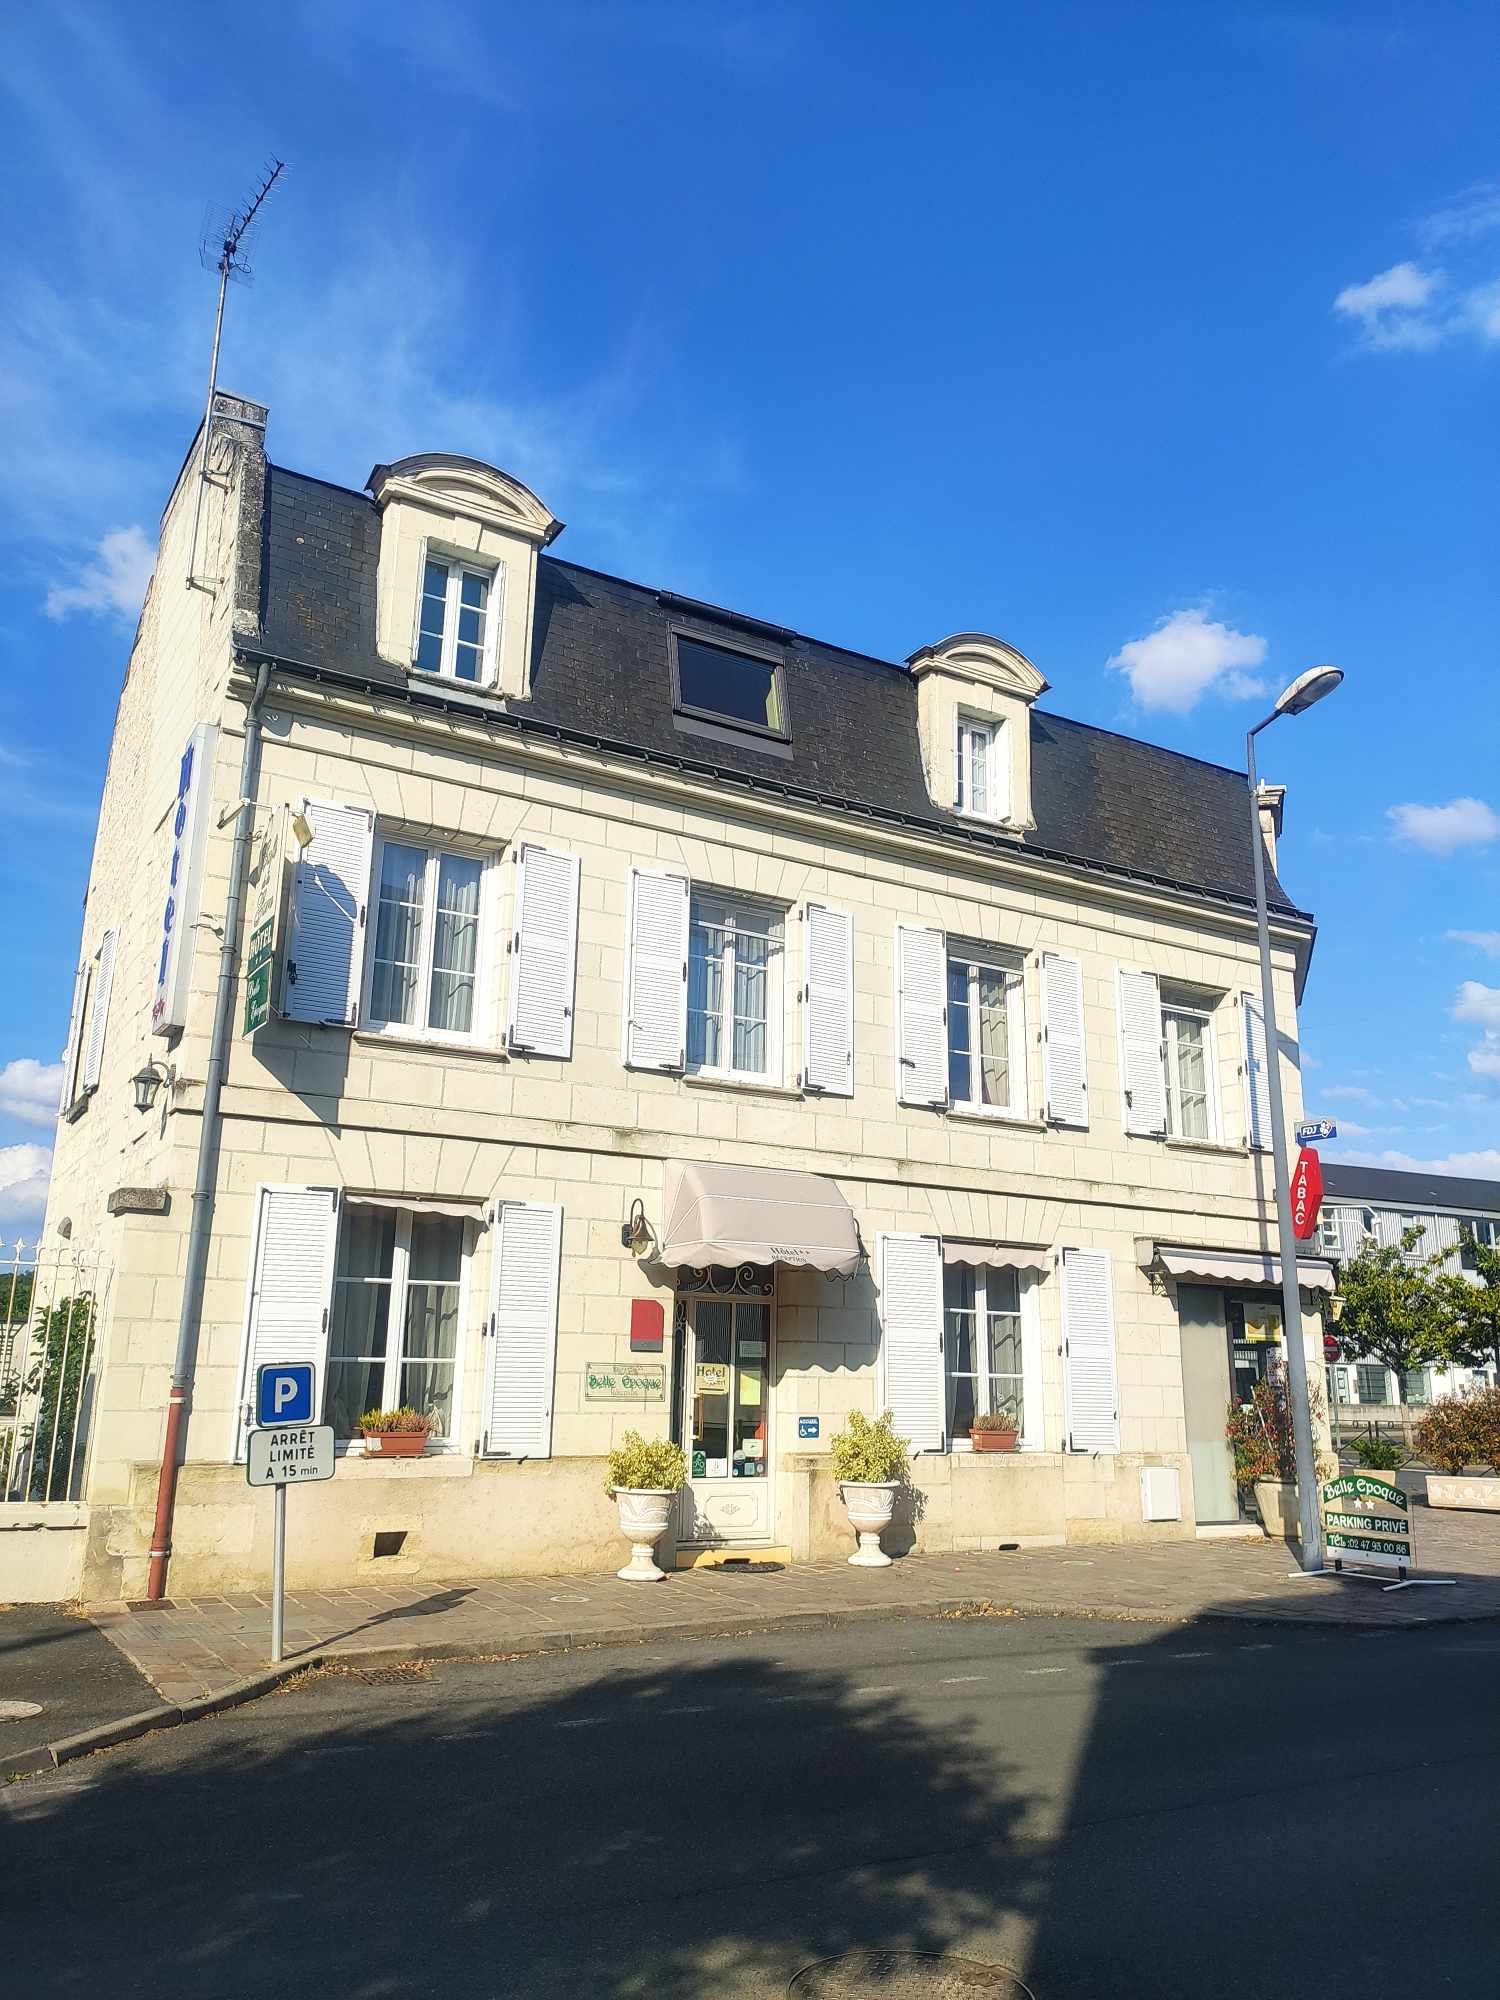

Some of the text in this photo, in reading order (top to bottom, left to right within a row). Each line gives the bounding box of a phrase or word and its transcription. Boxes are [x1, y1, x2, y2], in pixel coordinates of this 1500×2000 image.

[250, 924, 272, 961] HÔTEL
[1302, 1126, 1317, 1136] FDJ
[1295, 1161, 1308, 1225] TABAC
[588, 1374, 616, 1390] Belle
[274, 1376, 298, 1414] P
[270, 1430, 316, 1447] ARRÊT
[269, 1445, 315, 1463] LIMITÉ
[281, 1464, 297, 1478] 15
[299, 1465, 319, 1476] min
[1324, 1478, 1405, 1505] Belle Epoque
[1326, 1513, 1407, 1534] PARKING PRIVÉ
[1360, 1540, 1370, 1550] 47
[1383, 1542, 1394, 1553] 00
